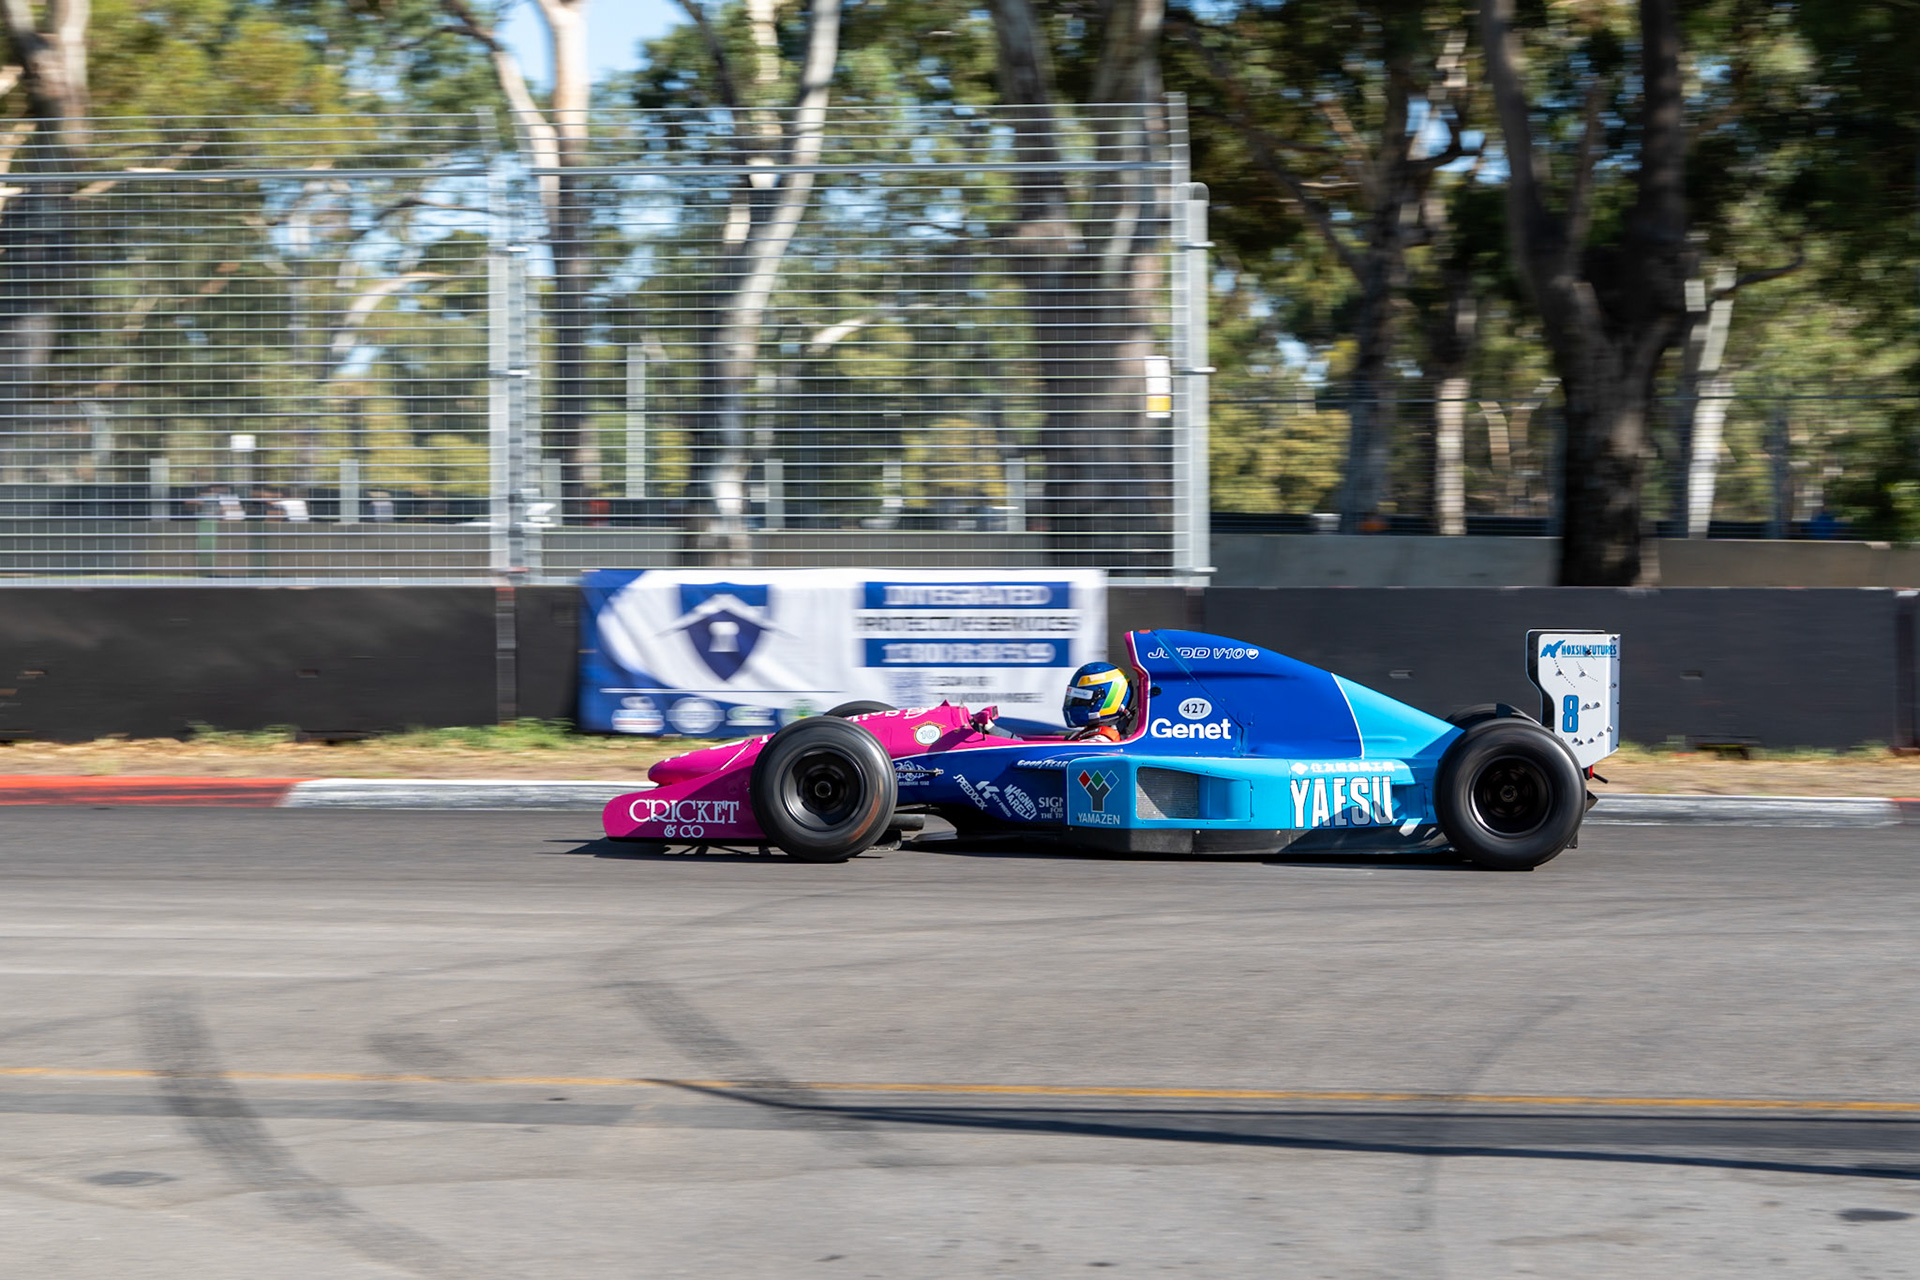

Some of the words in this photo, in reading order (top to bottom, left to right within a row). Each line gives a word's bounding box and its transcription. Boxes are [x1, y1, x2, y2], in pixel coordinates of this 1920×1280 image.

[1214, 648, 1245, 659] V10
[1184, 704, 1205, 714] 427
[1563, 695, 1580, 734] 8
[920, 731, 937, 739] 10
[1151, 718, 1232, 740] Genet
[1017, 760, 1069, 769] GOODYEAR
[1290, 776, 1394, 828] YAESU
[629, 799, 739, 824] CRICKET
[1078, 813, 1120, 825] YAMAZEN
[664, 825, 677, 838] &
[679, 825, 704, 838] CO
